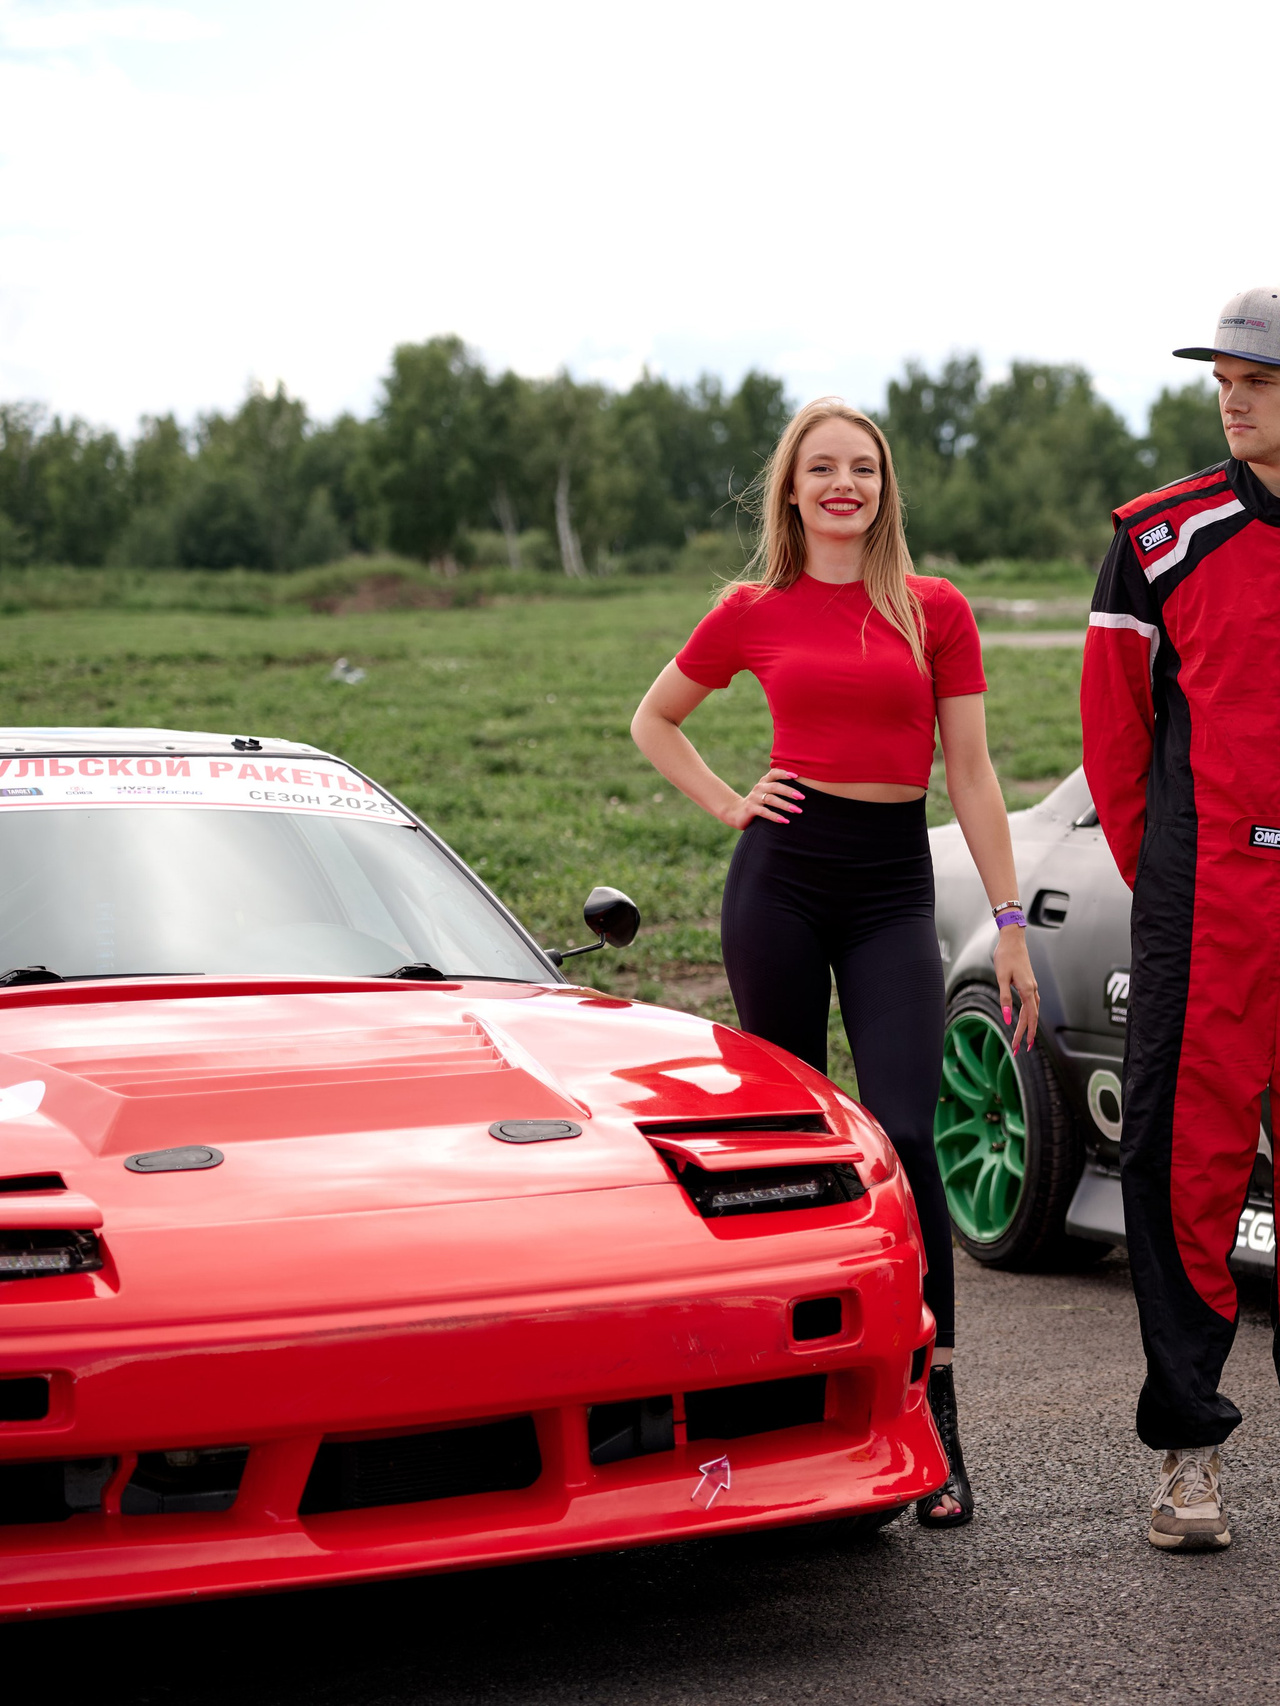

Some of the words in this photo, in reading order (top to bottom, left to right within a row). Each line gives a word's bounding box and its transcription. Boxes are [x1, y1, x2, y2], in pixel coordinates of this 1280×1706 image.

[1141, 526, 1169, 547] OMP
[209, 762, 374, 795] РАКЕТЫ
[249, 790, 320, 805] СЕЗОН
[328, 794, 396, 815] 2025
